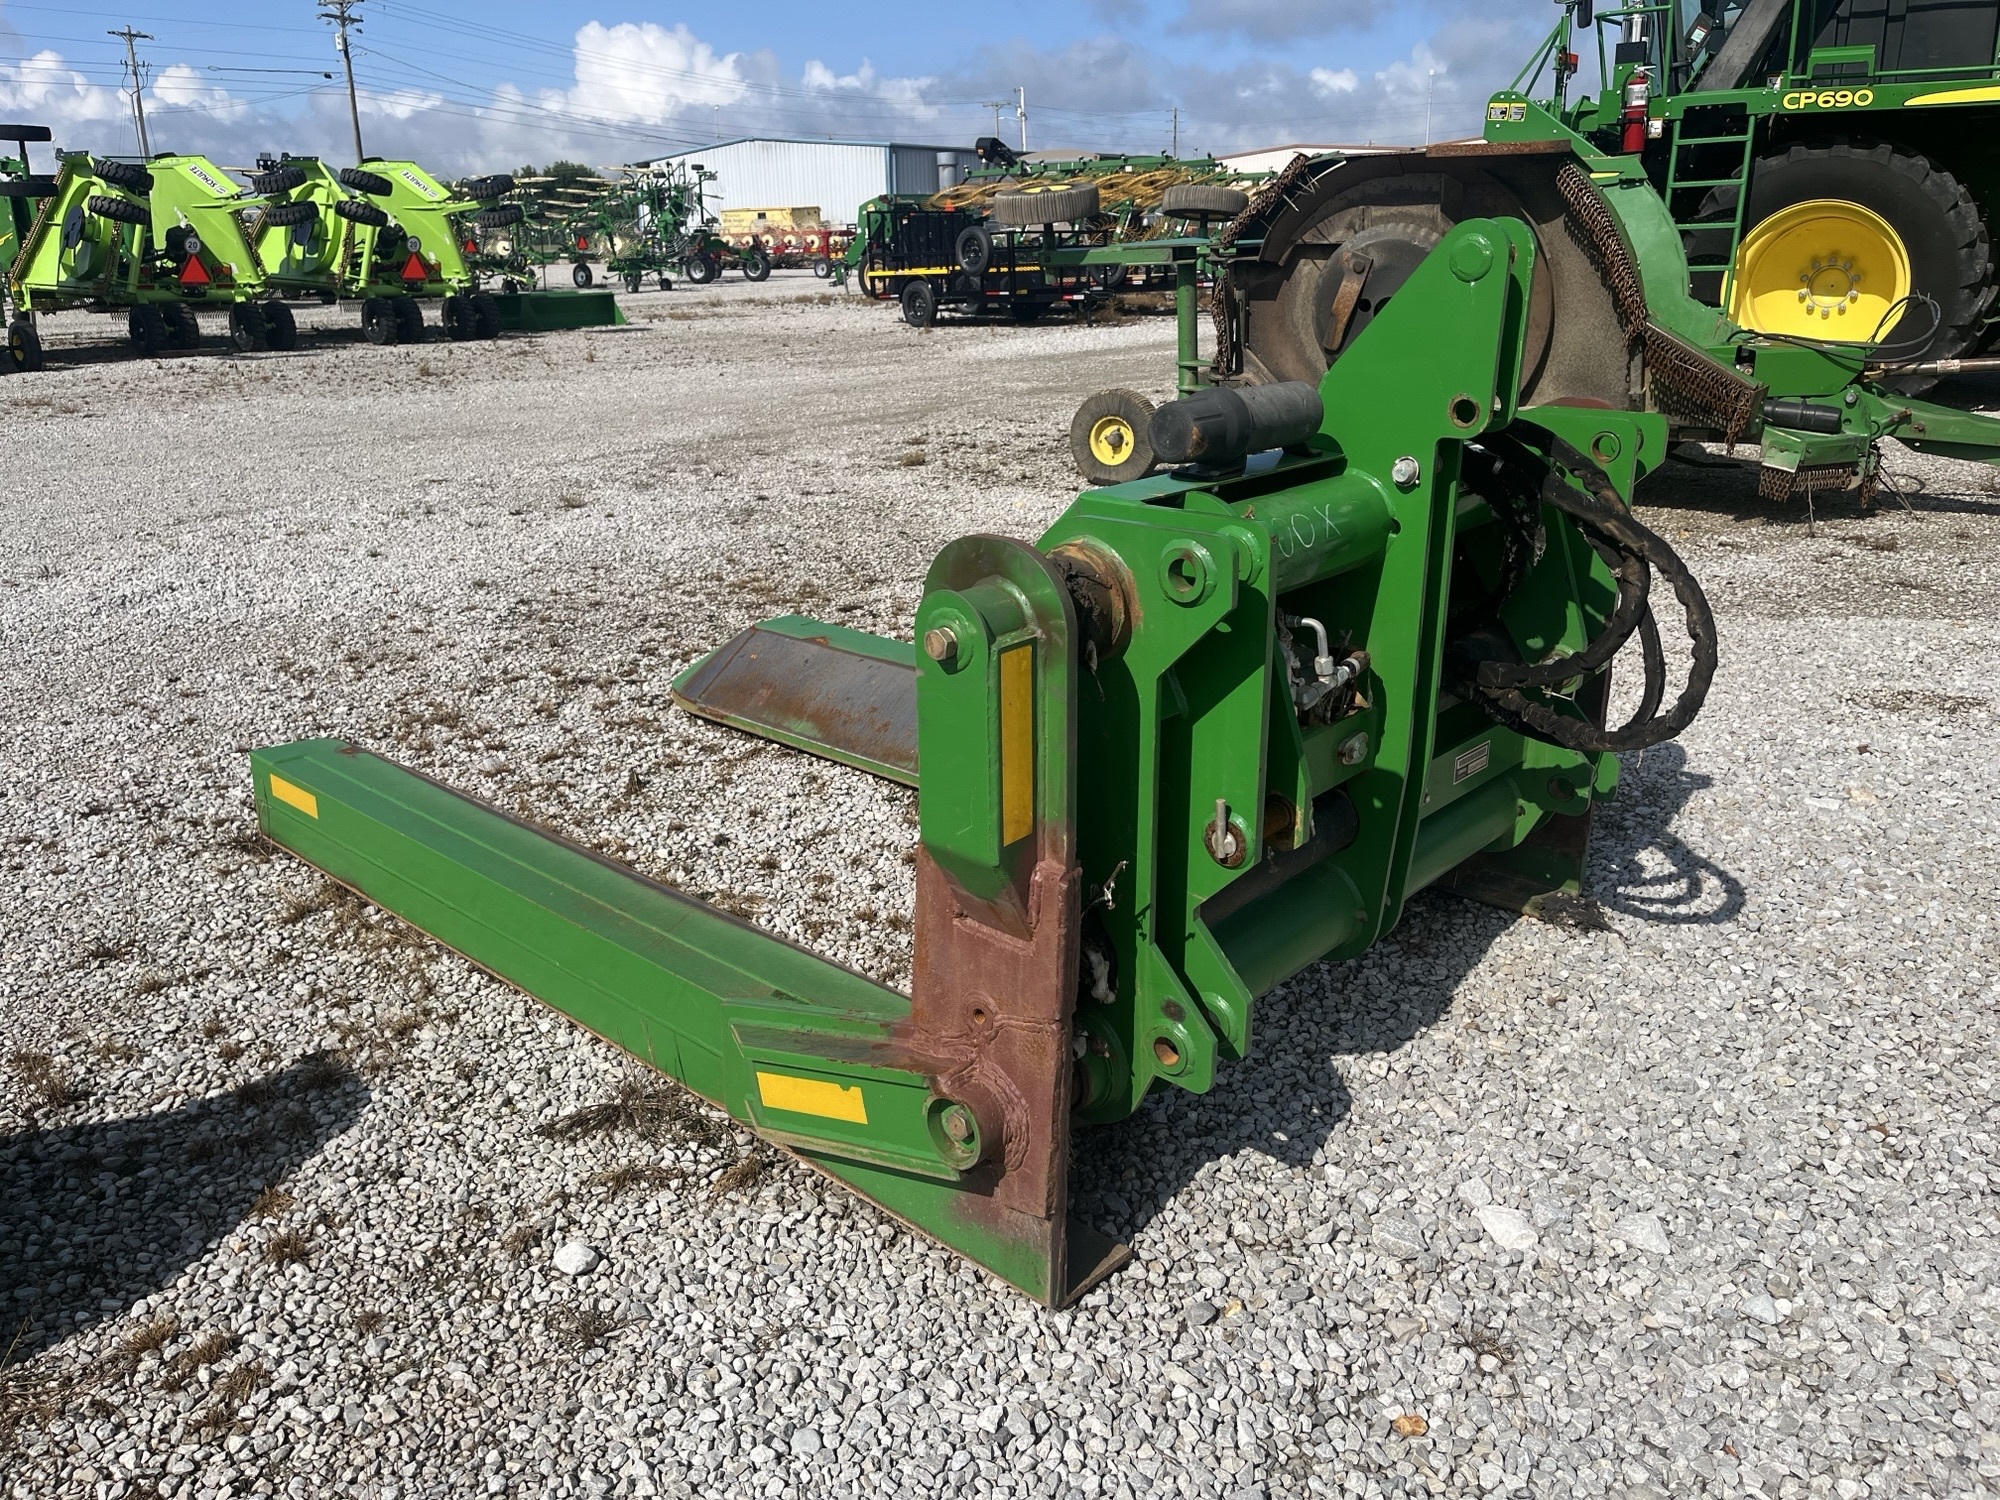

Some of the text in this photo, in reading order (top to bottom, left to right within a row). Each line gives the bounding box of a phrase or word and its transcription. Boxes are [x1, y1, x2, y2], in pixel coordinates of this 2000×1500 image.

[1782, 89, 1874, 110] CP690
[189, 164, 218, 188] SCHULTE
[187, 241, 199, 250] 20
[409, 240, 418, 249] 20
